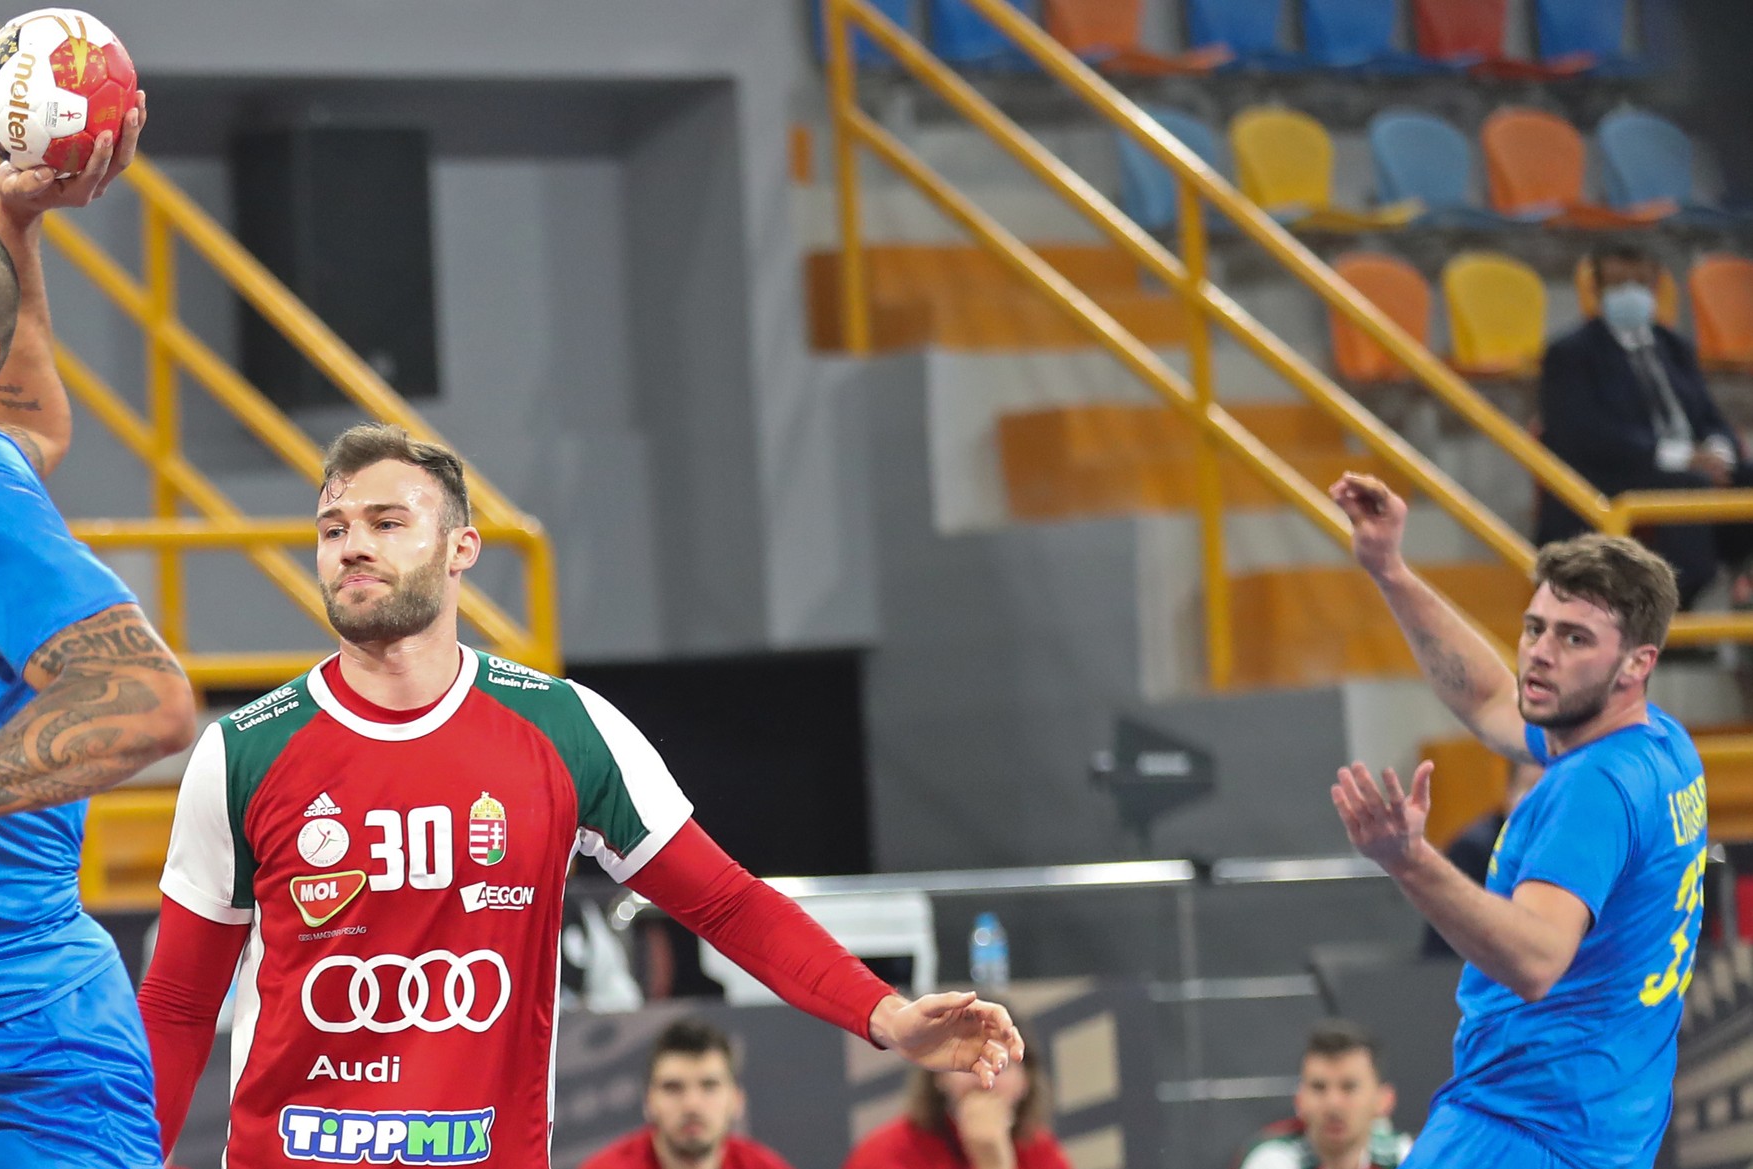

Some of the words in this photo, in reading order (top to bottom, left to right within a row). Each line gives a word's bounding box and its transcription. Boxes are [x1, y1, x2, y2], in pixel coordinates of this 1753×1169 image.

[8, 53, 36, 153] molten
[487, 672, 522, 689] Lutein
[521, 679, 550, 691] forte
[235, 711, 273, 732] Lutein
[273, 699, 300, 718] forte
[303, 806, 342, 818] adidas
[364, 805, 454, 892] 30
[299, 880, 340, 902] MOL
[475, 885, 536, 907] AEGON
[306, 1054, 402, 1083] Audi
